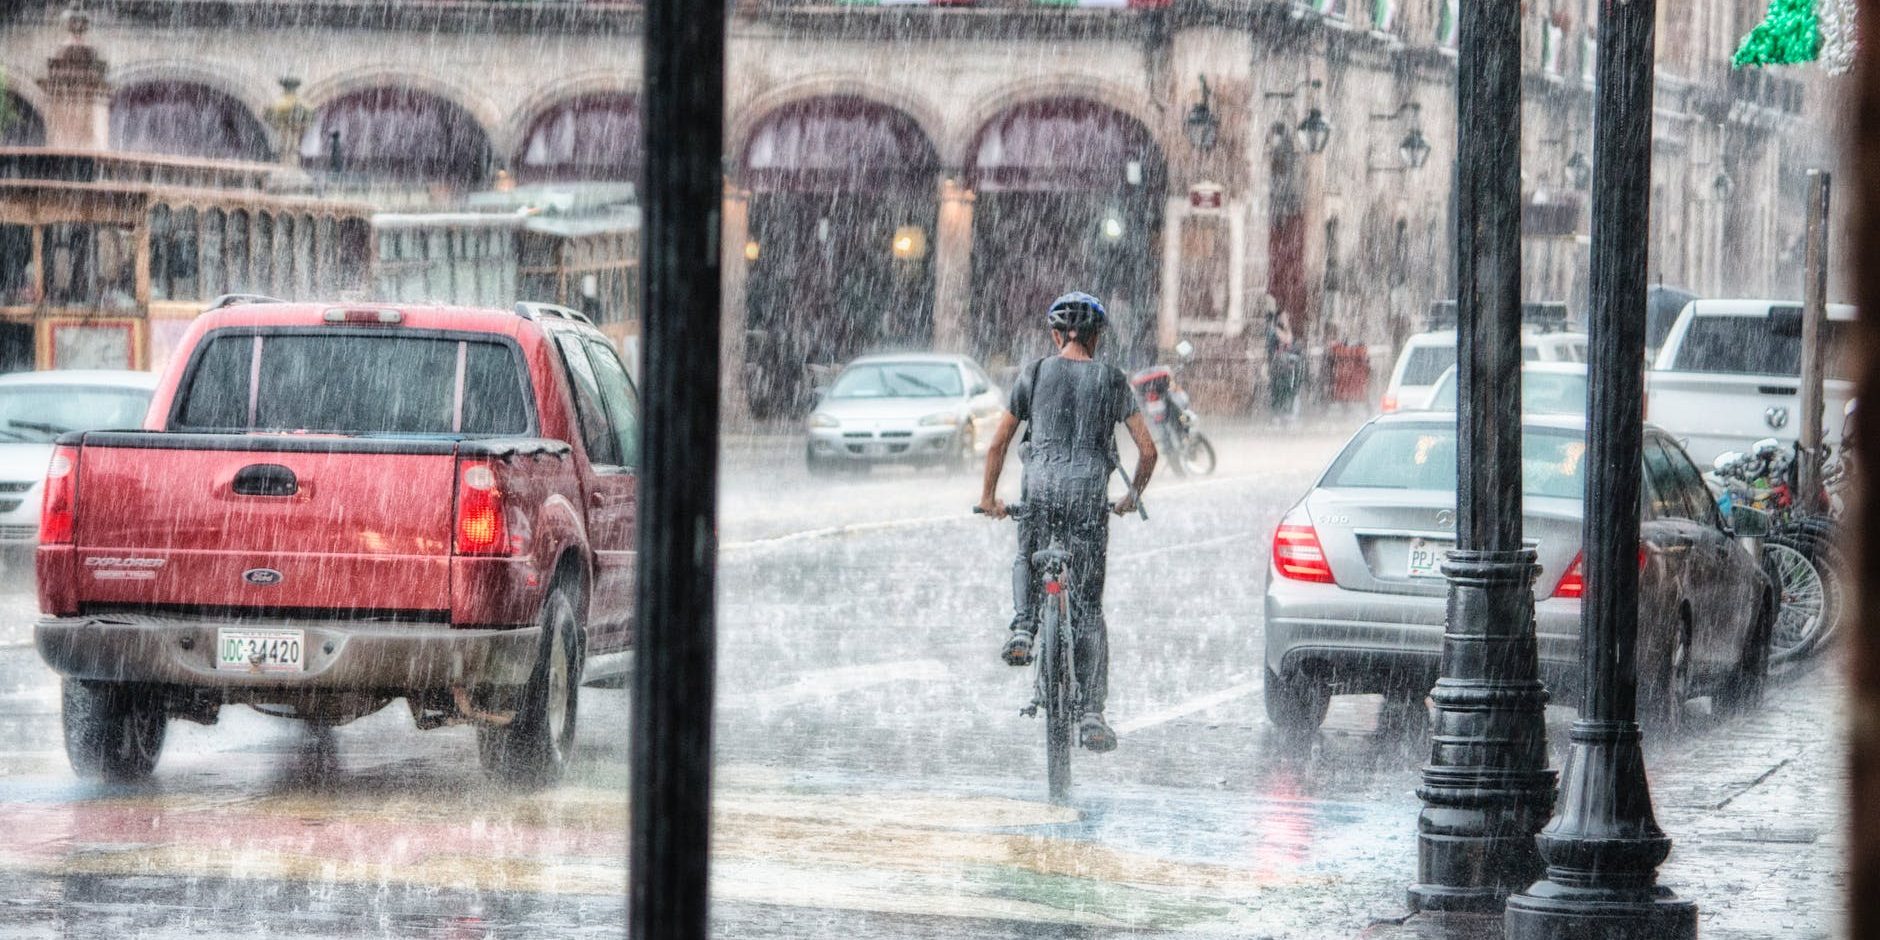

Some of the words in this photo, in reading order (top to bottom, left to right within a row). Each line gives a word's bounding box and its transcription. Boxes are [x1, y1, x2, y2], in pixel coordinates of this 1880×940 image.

[84, 557, 166, 567] EXPLORER
[1411, 551, 1447, 567] PPJ-
[222, 639, 299, 663] UDC-34420
